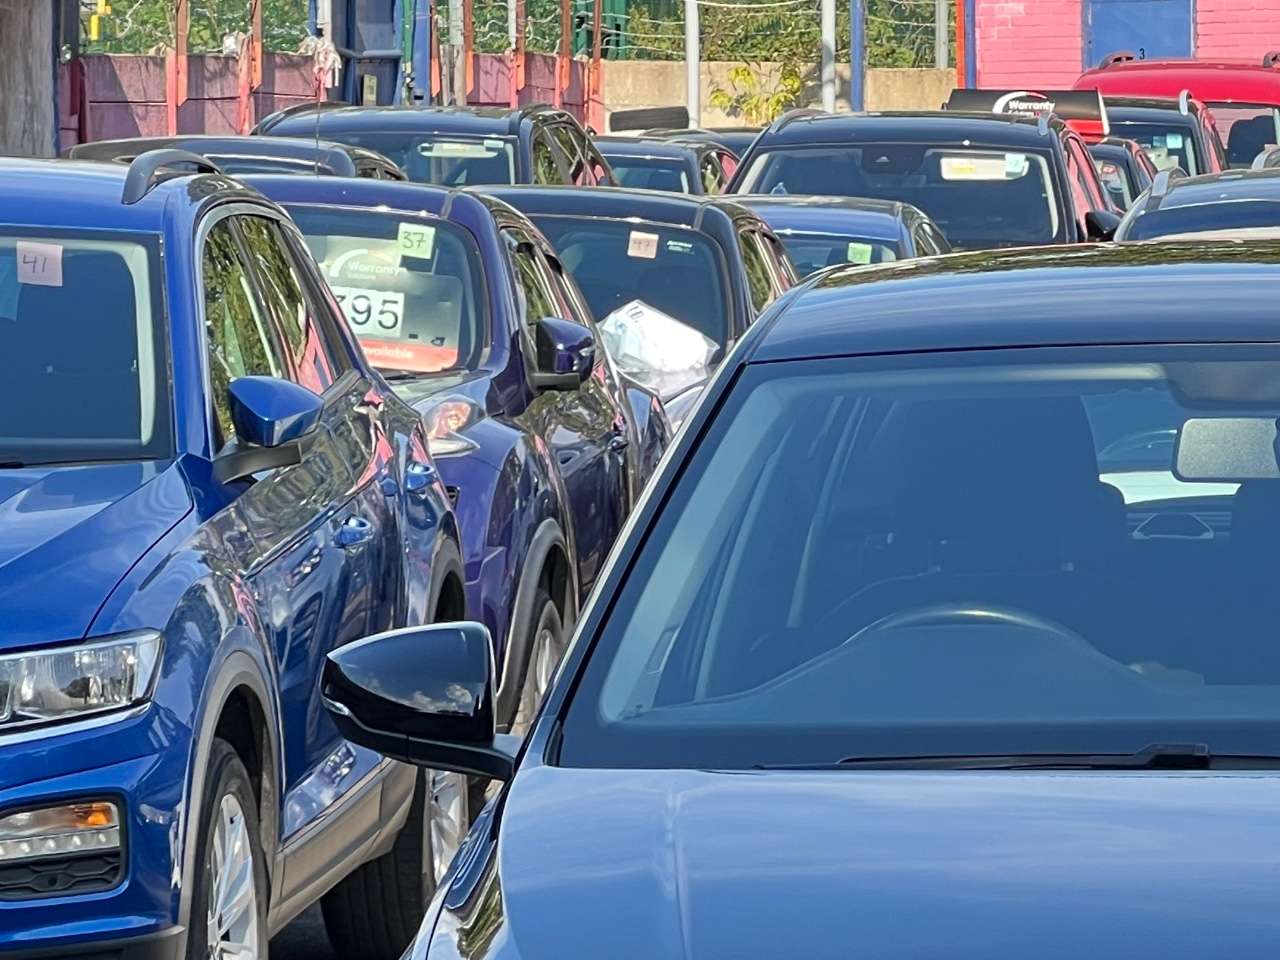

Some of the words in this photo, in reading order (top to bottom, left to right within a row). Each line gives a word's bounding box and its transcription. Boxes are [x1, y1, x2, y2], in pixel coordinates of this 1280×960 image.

[1139, 47, 1145, 60] 3
[1008, 100, 1055, 113] Warranty
[401, 230, 426, 249] 37
[22, 253, 48, 273] 41
[348, 260, 401, 277] Warranty
